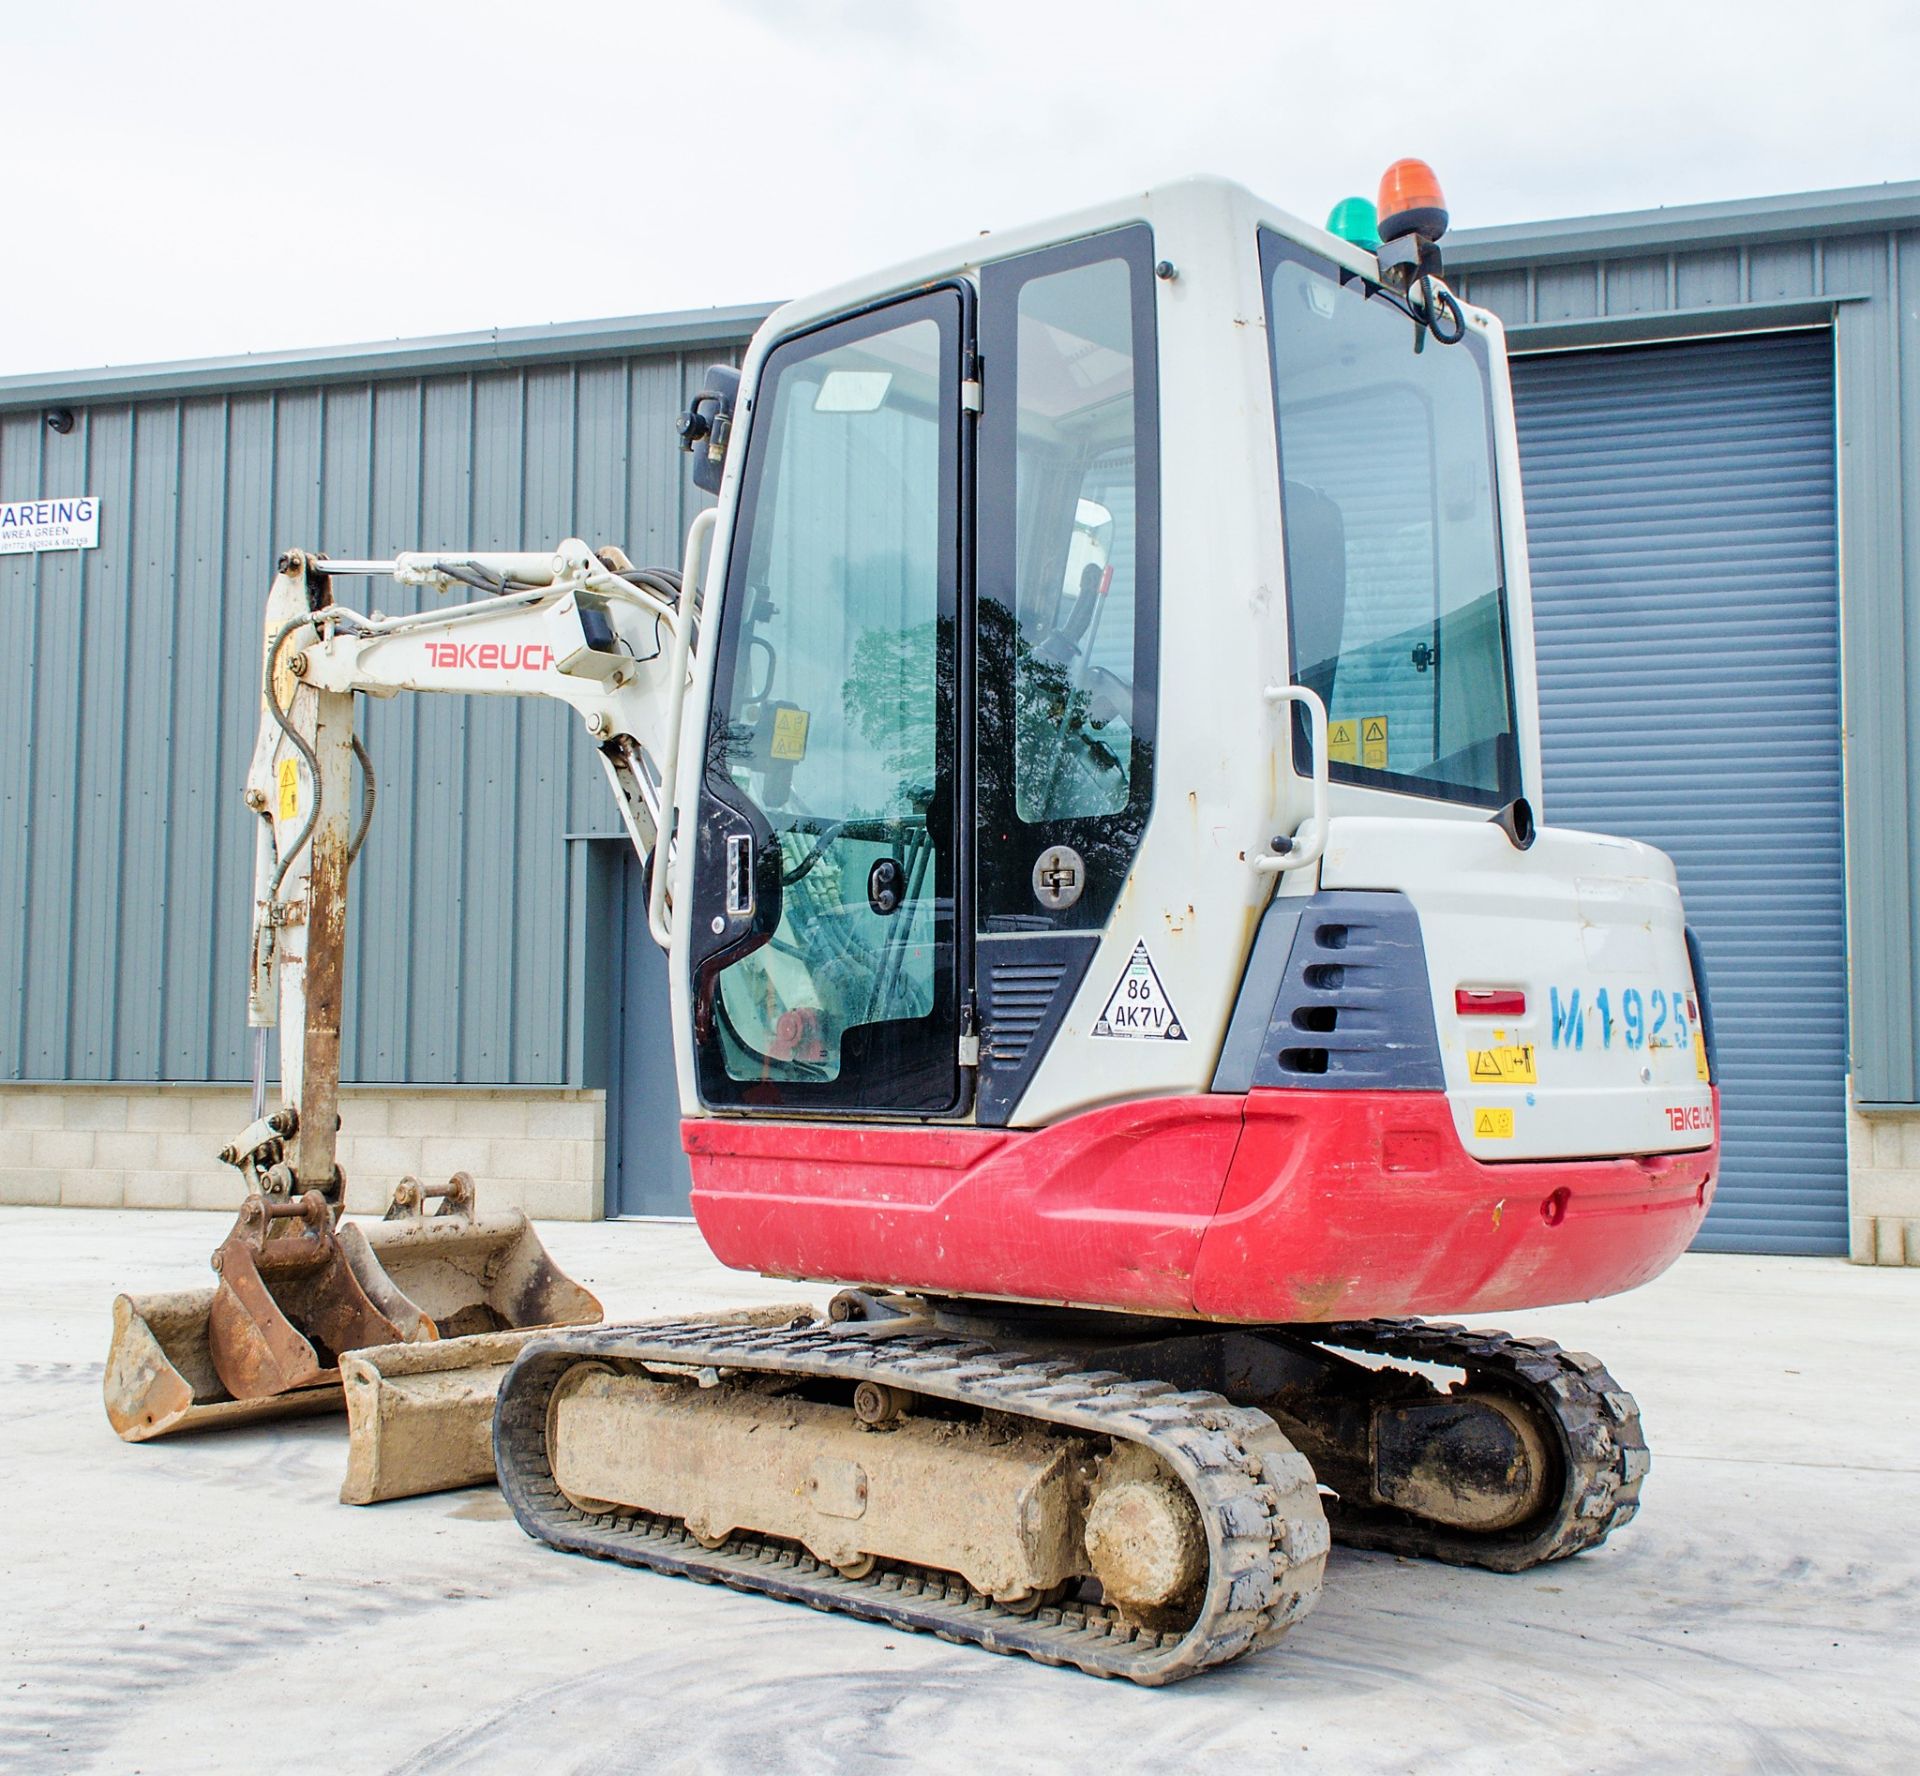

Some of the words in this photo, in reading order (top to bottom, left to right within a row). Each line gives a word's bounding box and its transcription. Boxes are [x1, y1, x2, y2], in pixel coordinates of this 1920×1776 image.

[0, 502, 92, 527] AREING
[2, 530, 31, 540] WREA
[34, 527, 69, 537] GREEN
[1127, 979, 1150, 1000] 86
[1115, 1006, 1165, 1027] AK7V
[1549, 986, 1688, 1051] M1925
